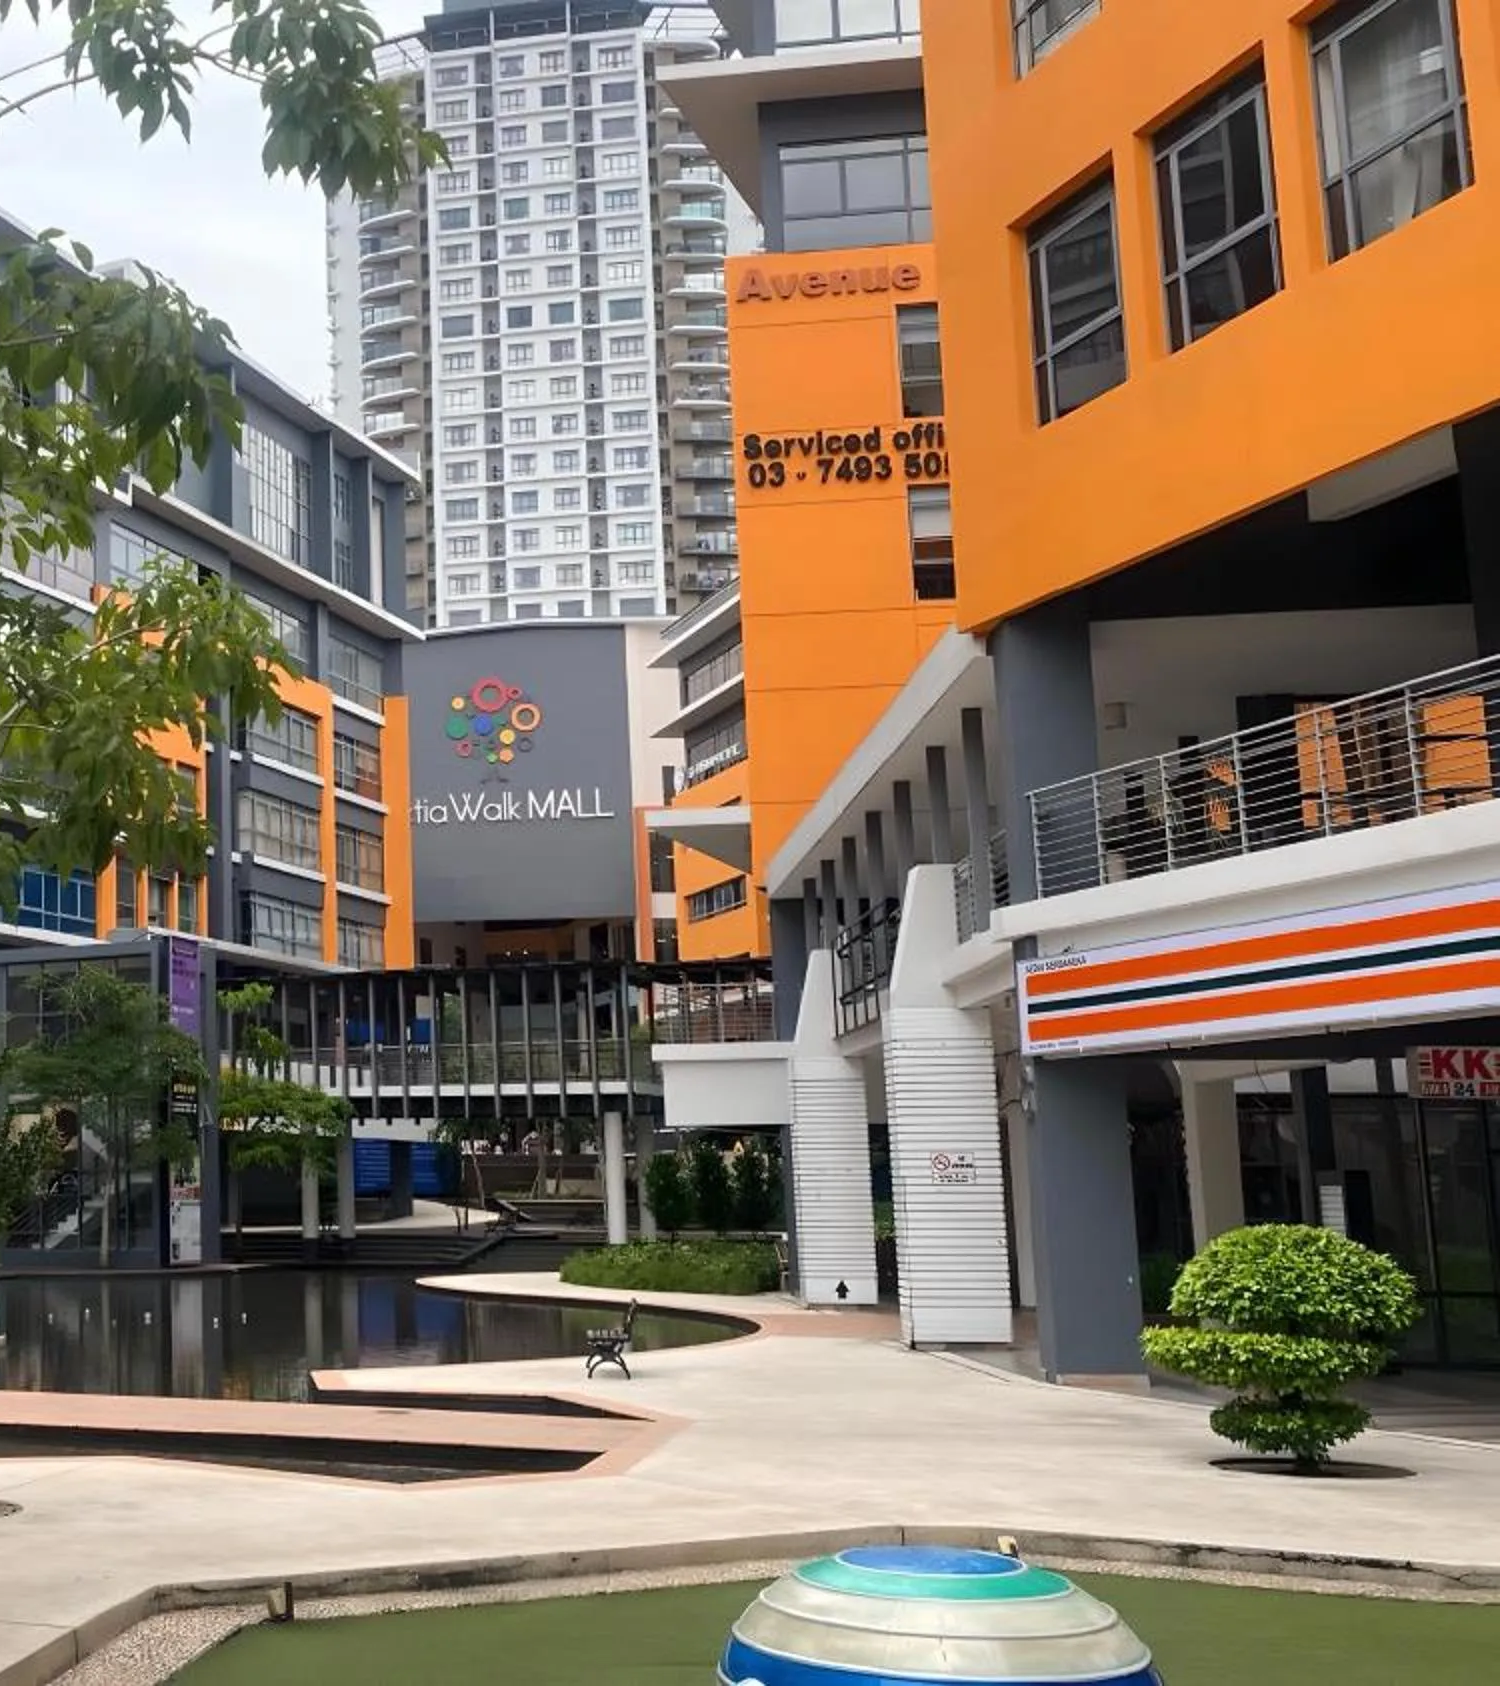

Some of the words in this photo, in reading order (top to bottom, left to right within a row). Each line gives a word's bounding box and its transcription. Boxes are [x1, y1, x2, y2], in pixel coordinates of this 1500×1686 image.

[736, 263, 921, 303] Avenue
[743, 426, 882, 461] Serviced
[748, 461, 786, 489] 03
[817, 454, 893, 484] 7493
[449, 791, 522, 822] Walk
[527, 787, 615, 820] MALL
[1431, 1048, 1493, 1079] KK
[1453, 1081, 1476, 1097] 24
